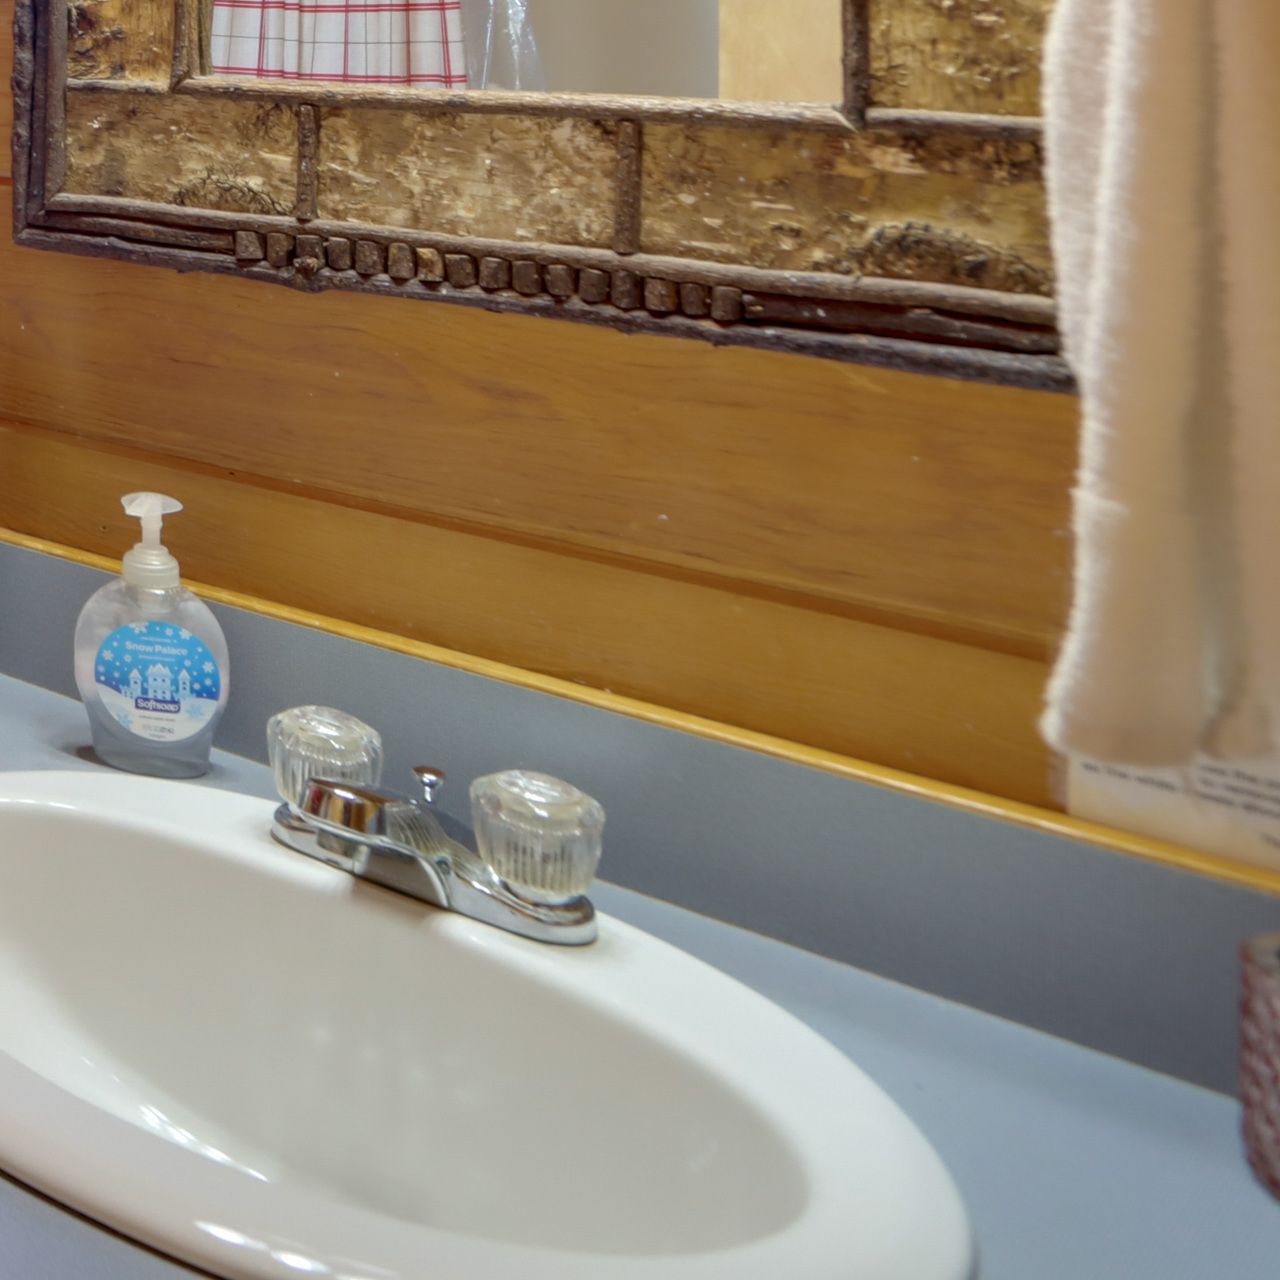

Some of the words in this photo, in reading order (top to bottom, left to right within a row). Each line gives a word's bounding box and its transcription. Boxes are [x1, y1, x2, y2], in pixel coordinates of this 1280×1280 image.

[125, 640, 154, 653] Snow
[154, 644, 188, 656] Palace
[136, 699, 179, 712] Softsoap
